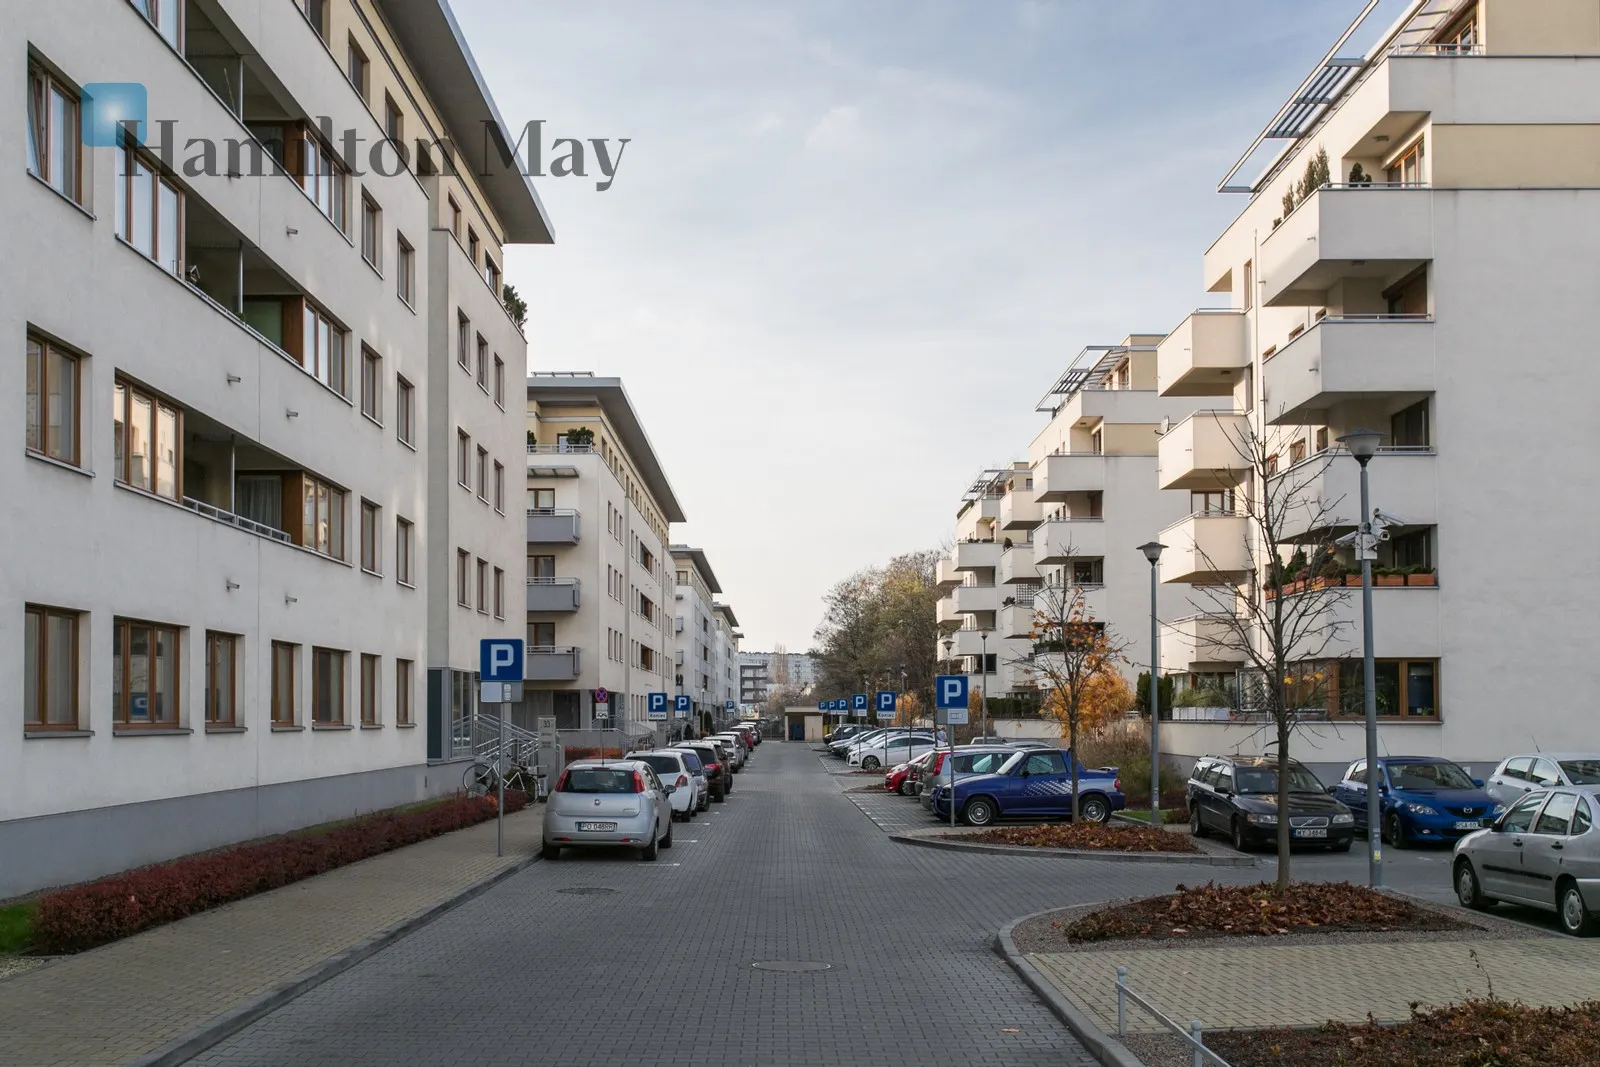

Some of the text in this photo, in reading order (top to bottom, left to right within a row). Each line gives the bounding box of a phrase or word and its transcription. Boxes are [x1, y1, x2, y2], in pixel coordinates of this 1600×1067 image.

[490, 644, 514, 676] P
[944, 679, 962, 704] P
[652, 695, 664, 710] P
[678, 697, 687, 709] P
[839, 700, 846, 709] P
[856, 696, 864, 708] P
[881, 694, 893, 709] P
